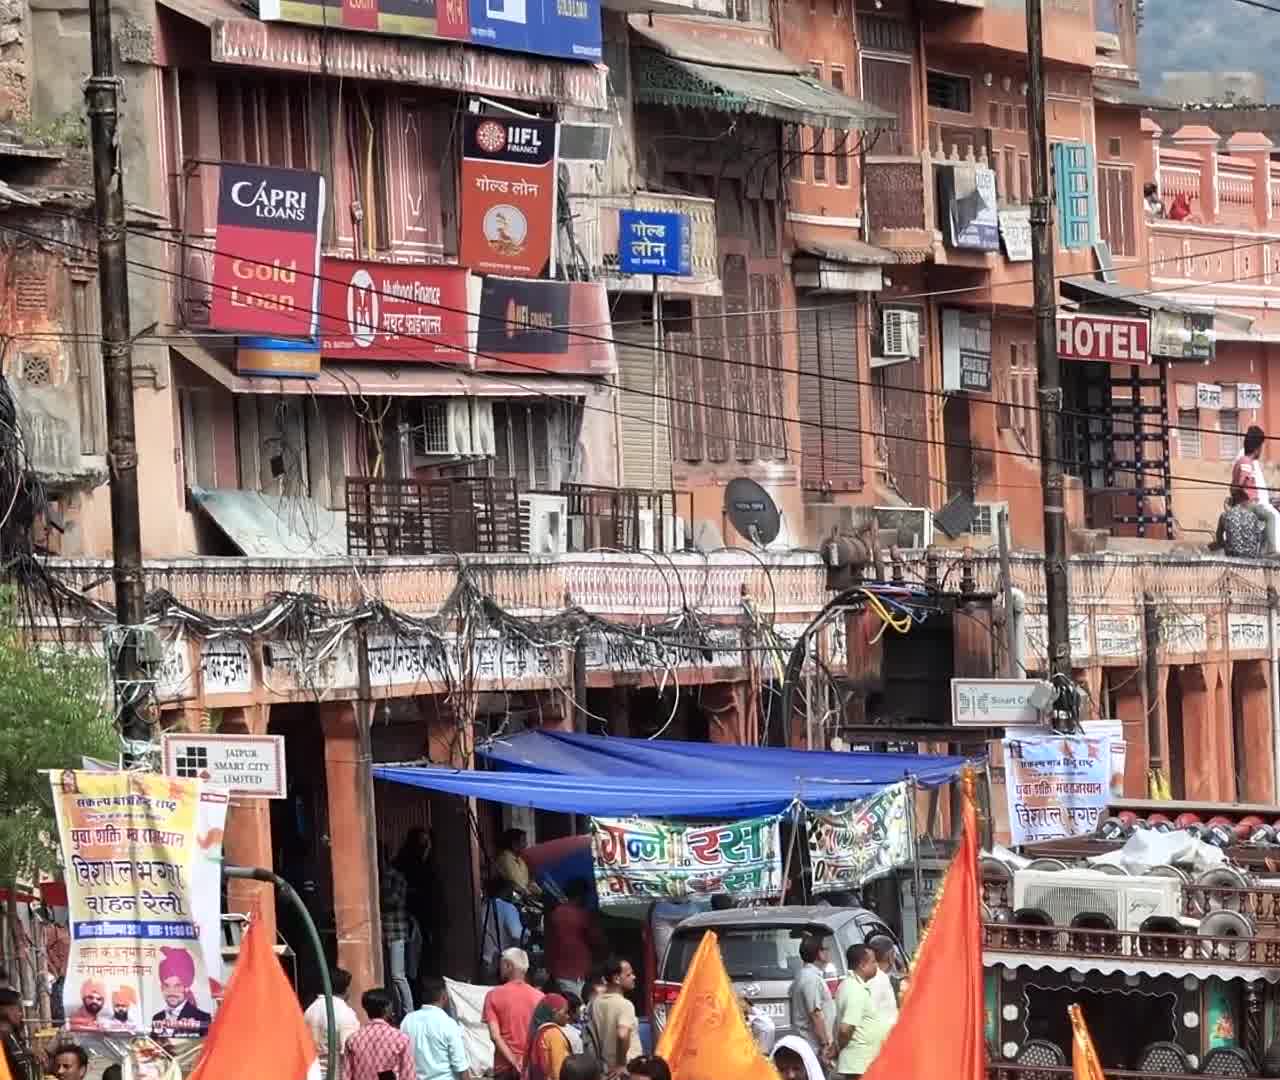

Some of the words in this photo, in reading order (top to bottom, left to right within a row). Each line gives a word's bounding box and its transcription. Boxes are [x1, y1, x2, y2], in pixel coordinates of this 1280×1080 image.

[508, 126, 542, 146] IIFL
[507, 144, 539, 154] FINANCE
[231, 180, 307, 209] CAPRI
[475, 173, 510, 193] गोल्ड
[512, 180, 539, 196] लोन
[256, 206, 305, 221] LOANS
[631, 220, 665, 238] गोल्ड
[631, 237, 666, 257] लोन
[232, 258, 296, 284] Gold
[231, 285, 295, 312] Loan
[382, 279, 413, 304] Muthoot
[414, 283, 441, 305] Finance
[1056, 319, 1146, 360] HOTEL
[225, 749, 258, 759] JAIPUR
[214, 762, 245, 771] SMART
[247, 762, 271, 772] CITY
[223, 774, 263, 785] LIMITED
[598, 822, 668, 867] गन्ने
[687, 818, 764, 864] रस
[85, 895, 137, 914] वाहन
